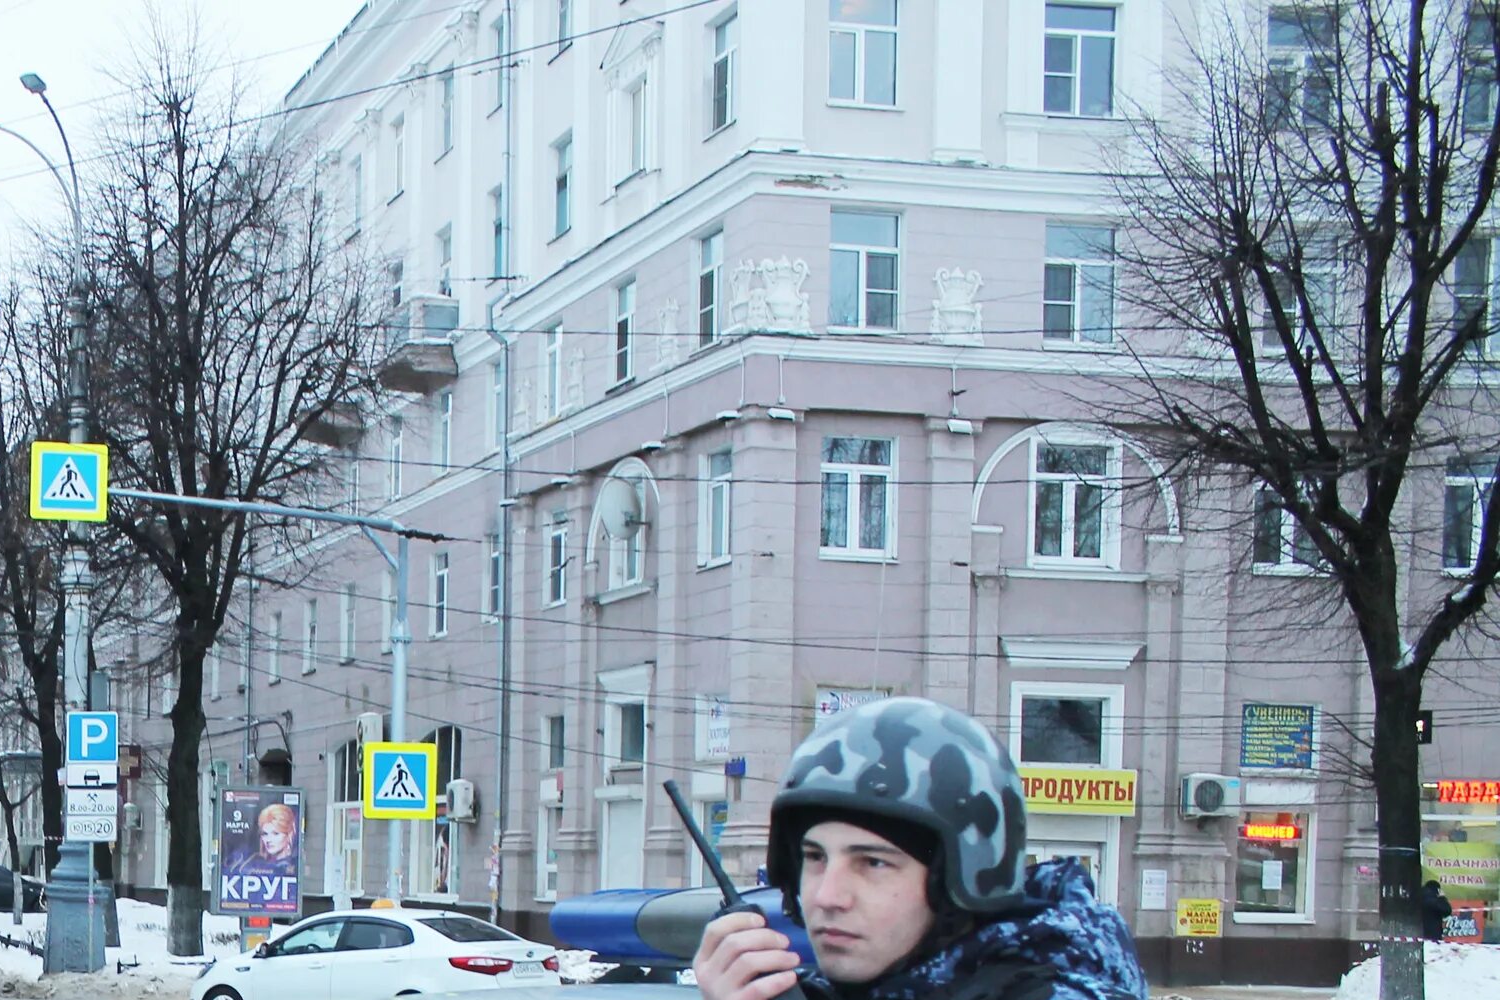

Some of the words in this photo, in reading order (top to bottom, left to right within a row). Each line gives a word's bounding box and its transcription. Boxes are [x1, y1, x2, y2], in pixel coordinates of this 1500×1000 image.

[1245, 706, 1310, 721] СУВЕНИРЫ
[81, 718, 108, 758] P
[1021, 777, 1134, 805] ПРОДУКТЫ
[233, 810, 242, 821] 9
[83, 823, 93, 832] 15
[96, 823, 110, 833] 20
[226, 822, 250, 830] МАРТА
[1428, 859, 1498, 868] ТАБАЧНАЯ
[1440, 875, 1484, 884] ЛАВКА
[221, 875, 297, 900] КРУГ
